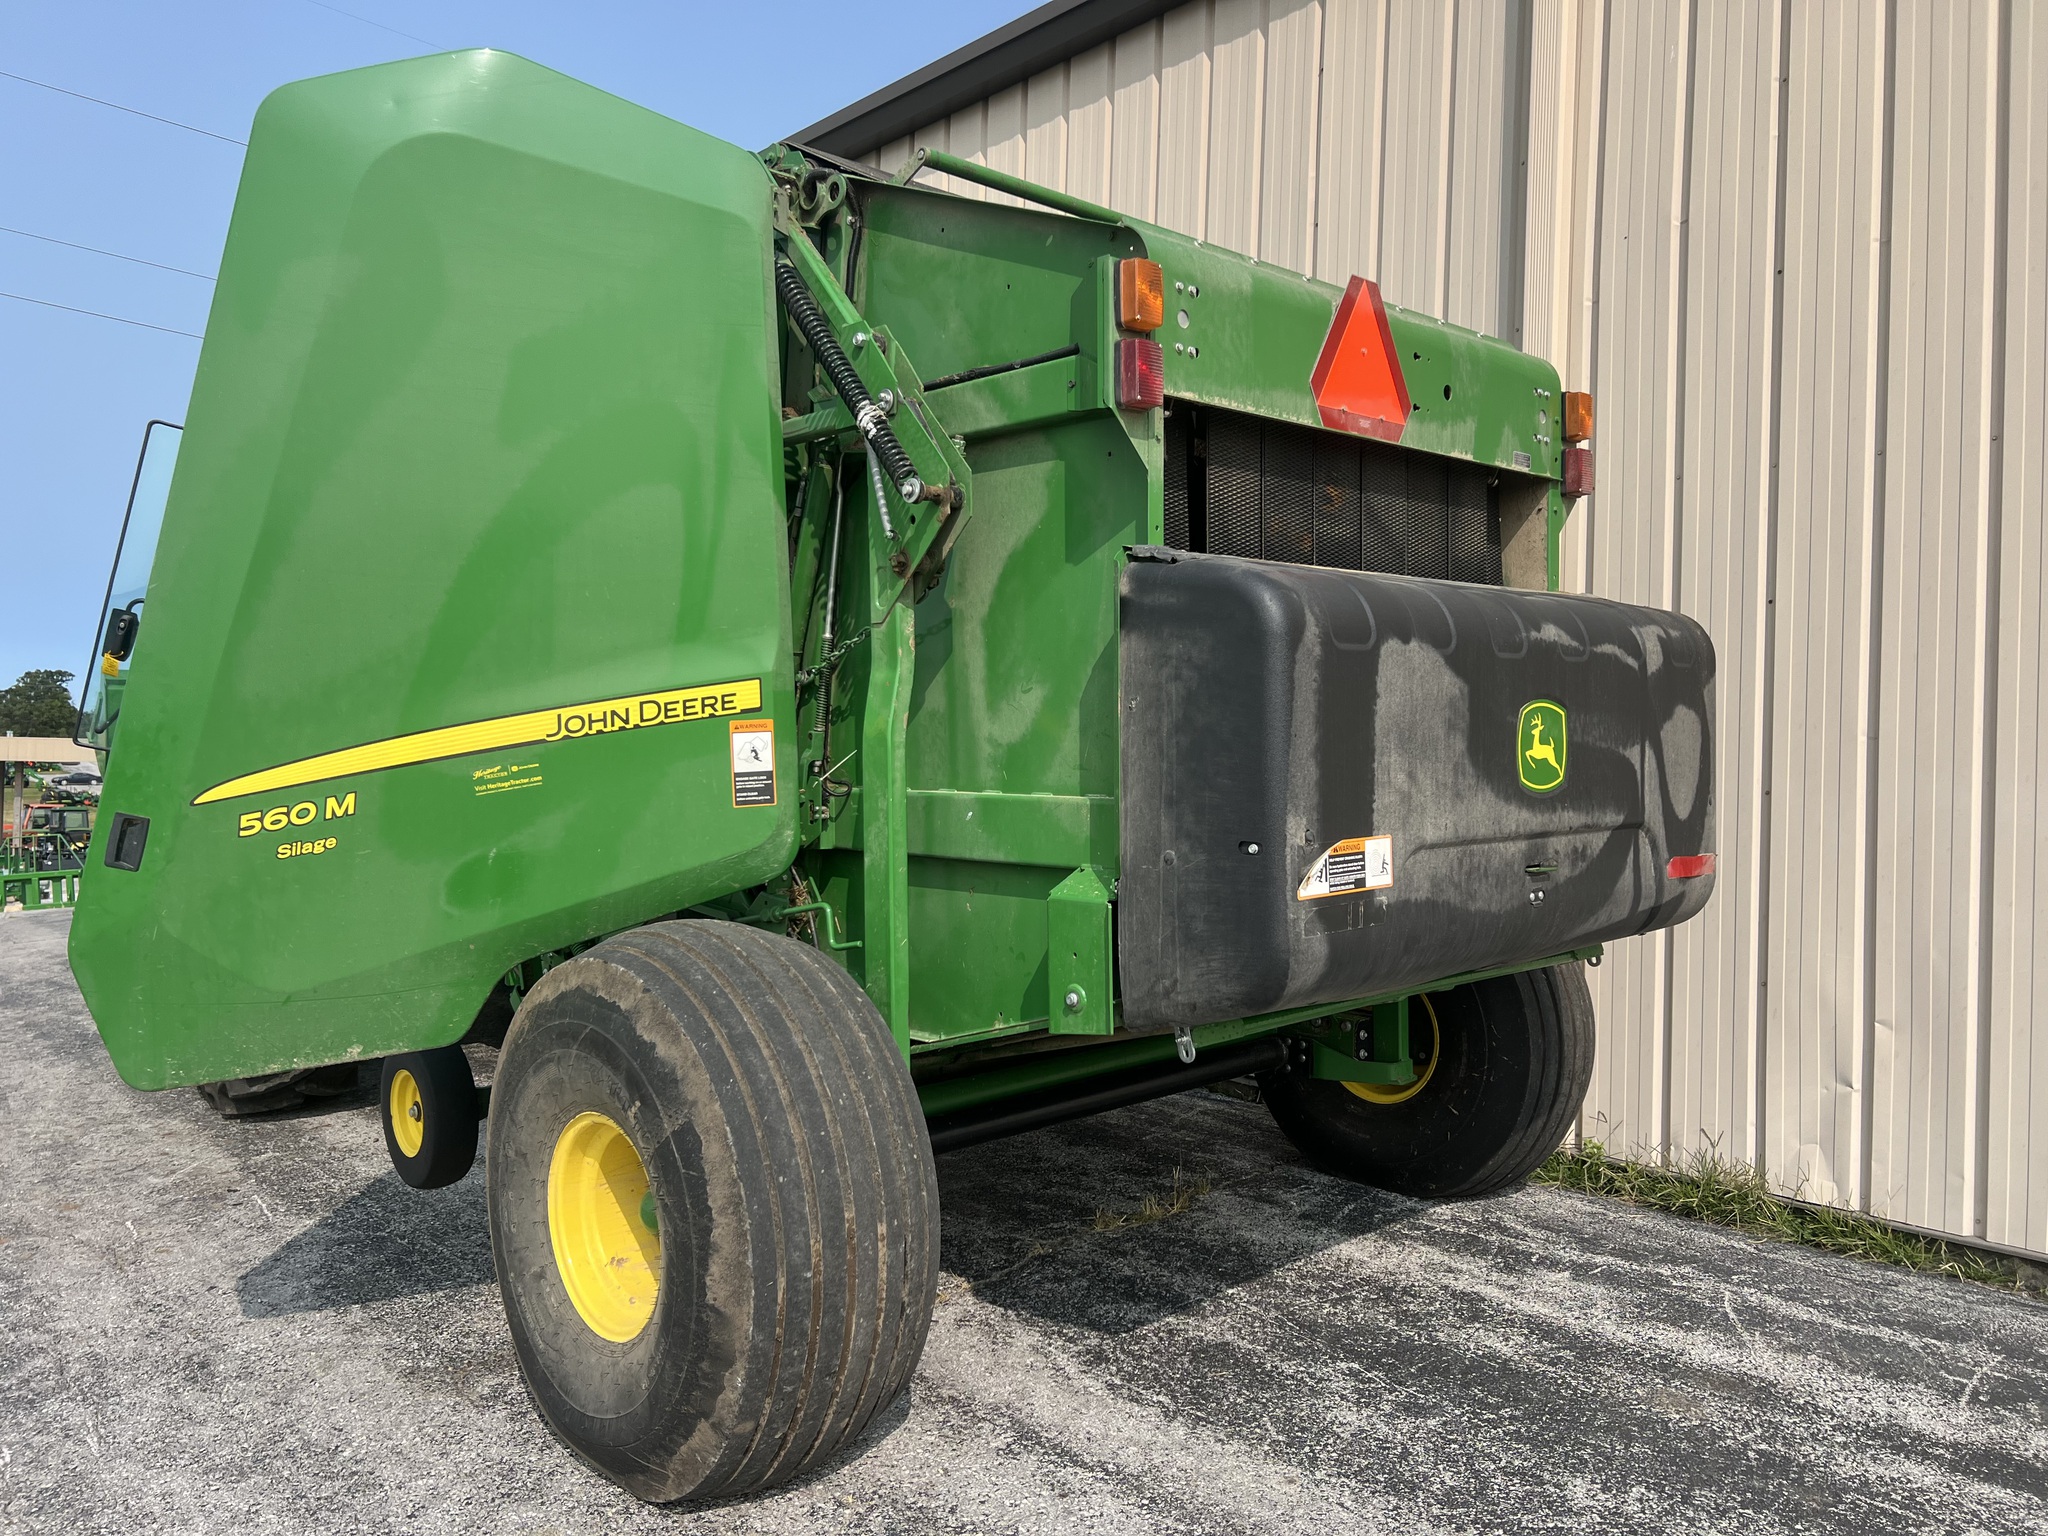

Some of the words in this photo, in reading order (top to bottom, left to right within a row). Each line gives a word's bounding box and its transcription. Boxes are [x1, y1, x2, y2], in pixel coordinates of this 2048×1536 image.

[545, 706, 631, 739] JOHN
[638, 692, 738, 724] DEERE
[472, 765, 502, 780] Heritage
[474, 784, 487, 792] Visit
[487, 776, 543, 790] HeritageTractor.com
[239, 802, 318, 838] 560
[324, 791, 357, 821] M
[276, 836, 338, 860] Silage
[1338, 843, 1360, 851] WARNING
